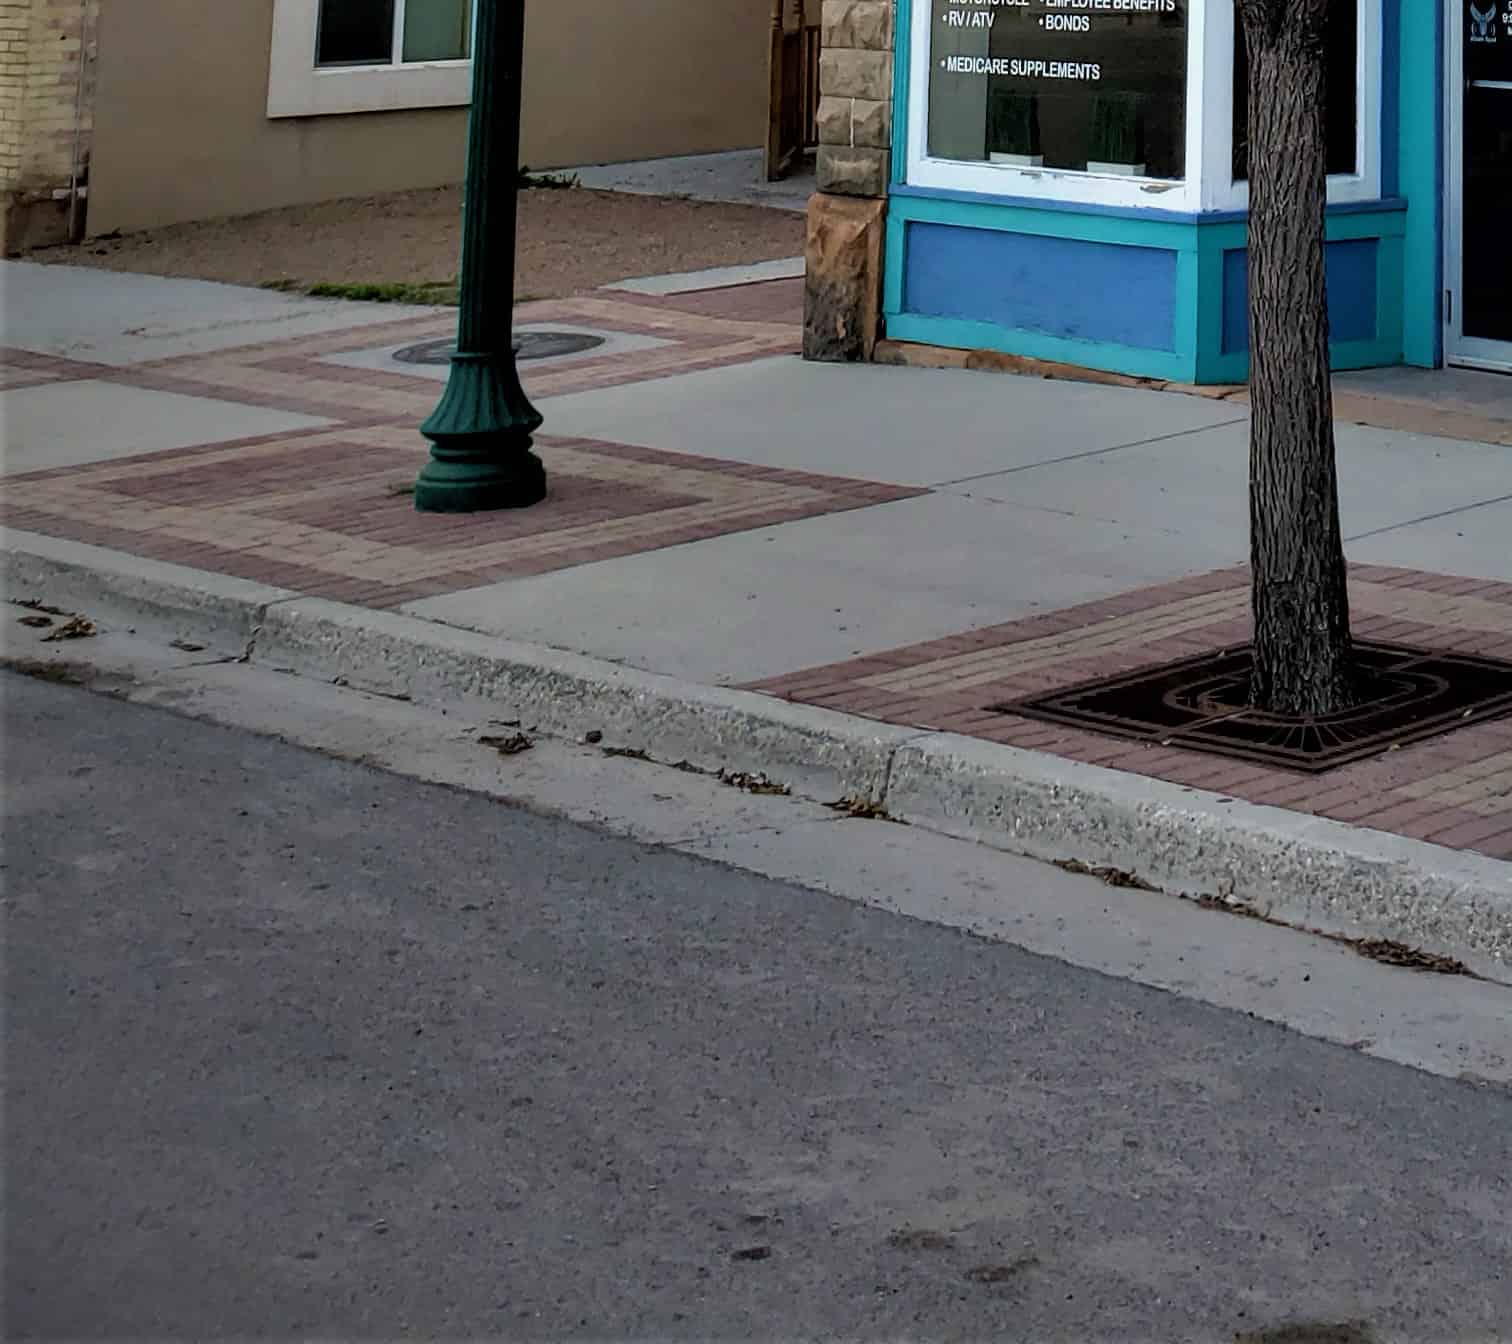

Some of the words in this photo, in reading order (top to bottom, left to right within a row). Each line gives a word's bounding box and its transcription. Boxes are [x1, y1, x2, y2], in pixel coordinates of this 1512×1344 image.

[949, 11, 966, 27] RV
[971, 12, 995, 28] ATV
[1045, 15, 1090, 32] BONDS
[947, 57, 1008, 75] MEDICARE
[1010, 60, 1101, 80] SUPPLEMENTS
